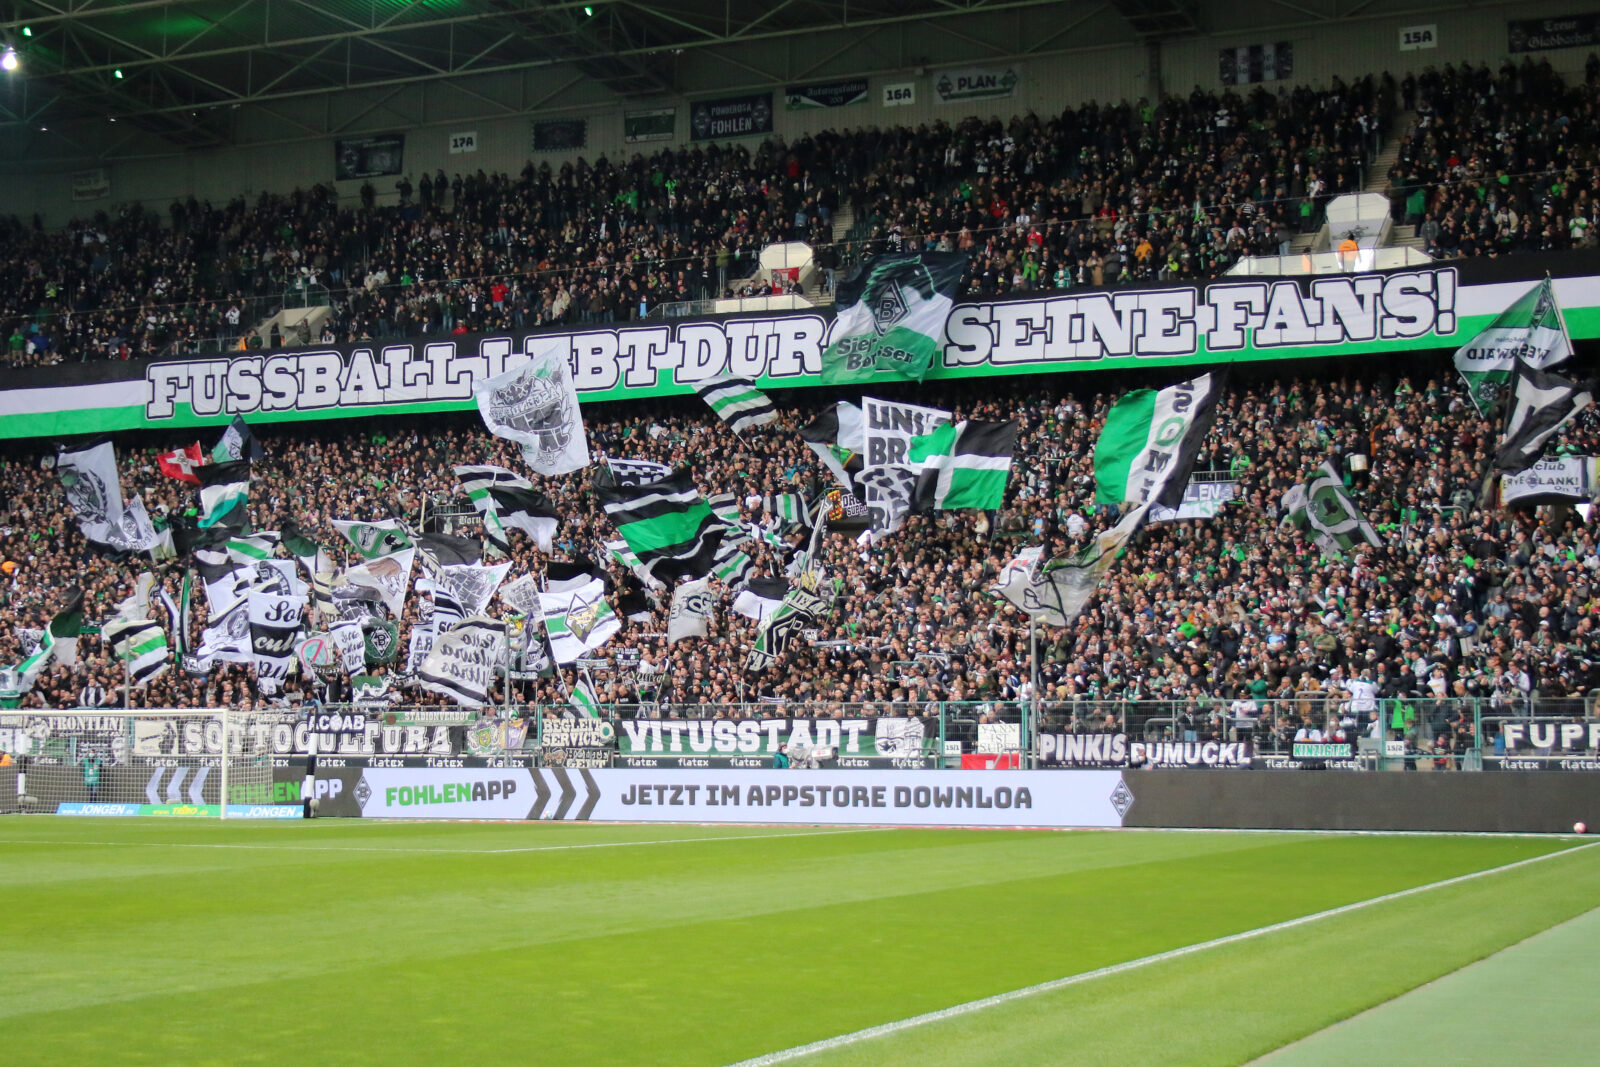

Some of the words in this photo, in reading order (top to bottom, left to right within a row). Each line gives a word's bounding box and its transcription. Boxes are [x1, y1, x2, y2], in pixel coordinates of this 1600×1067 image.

[1403, 31, 1432, 44] 15A
[958, 75, 996, 90] PLAN
[887, 89, 912, 101] 16A
[711, 103, 752, 116] PONDEROSA
[711, 117, 752, 135] FOHLEN
[452, 137, 473, 148] 17A
[146, 343, 474, 419] FUSSBALL
[943, 286, 1199, 368] SEINE
[1206, 267, 1459, 350] FANS!
[542, 718, 601, 733] BEGLEIT
[541, 732, 602, 748] SERVICE
[622, 720, 868, 753] VITUSSTADT
[1040, 733, 1127, 762] PINKIS
[1293, 743, 1351, 757] KINZIGTAL
[146, 758, 179, 767] flatex
[368, 759, 404, 767] flatex
[426, 759, 463, 767] flatex
[627, 758, 657, 767] flatex
[678, 759, 709, 767] flatex
[730, 759, 761, 767] flatex
[837, 759, 870, 767] flatex
[1265, 760, 1302, 769] flatex
[1499, 760, 1539, 769] flatex
[1560, 760, 1600, 769] flatex
[621, 784, 700, 806] JETZT
[706, 784, 740, 806] IM
[747, 785, 887, 807] APPSTORE
[894, 786, 1032, 809] DOWNLOA
